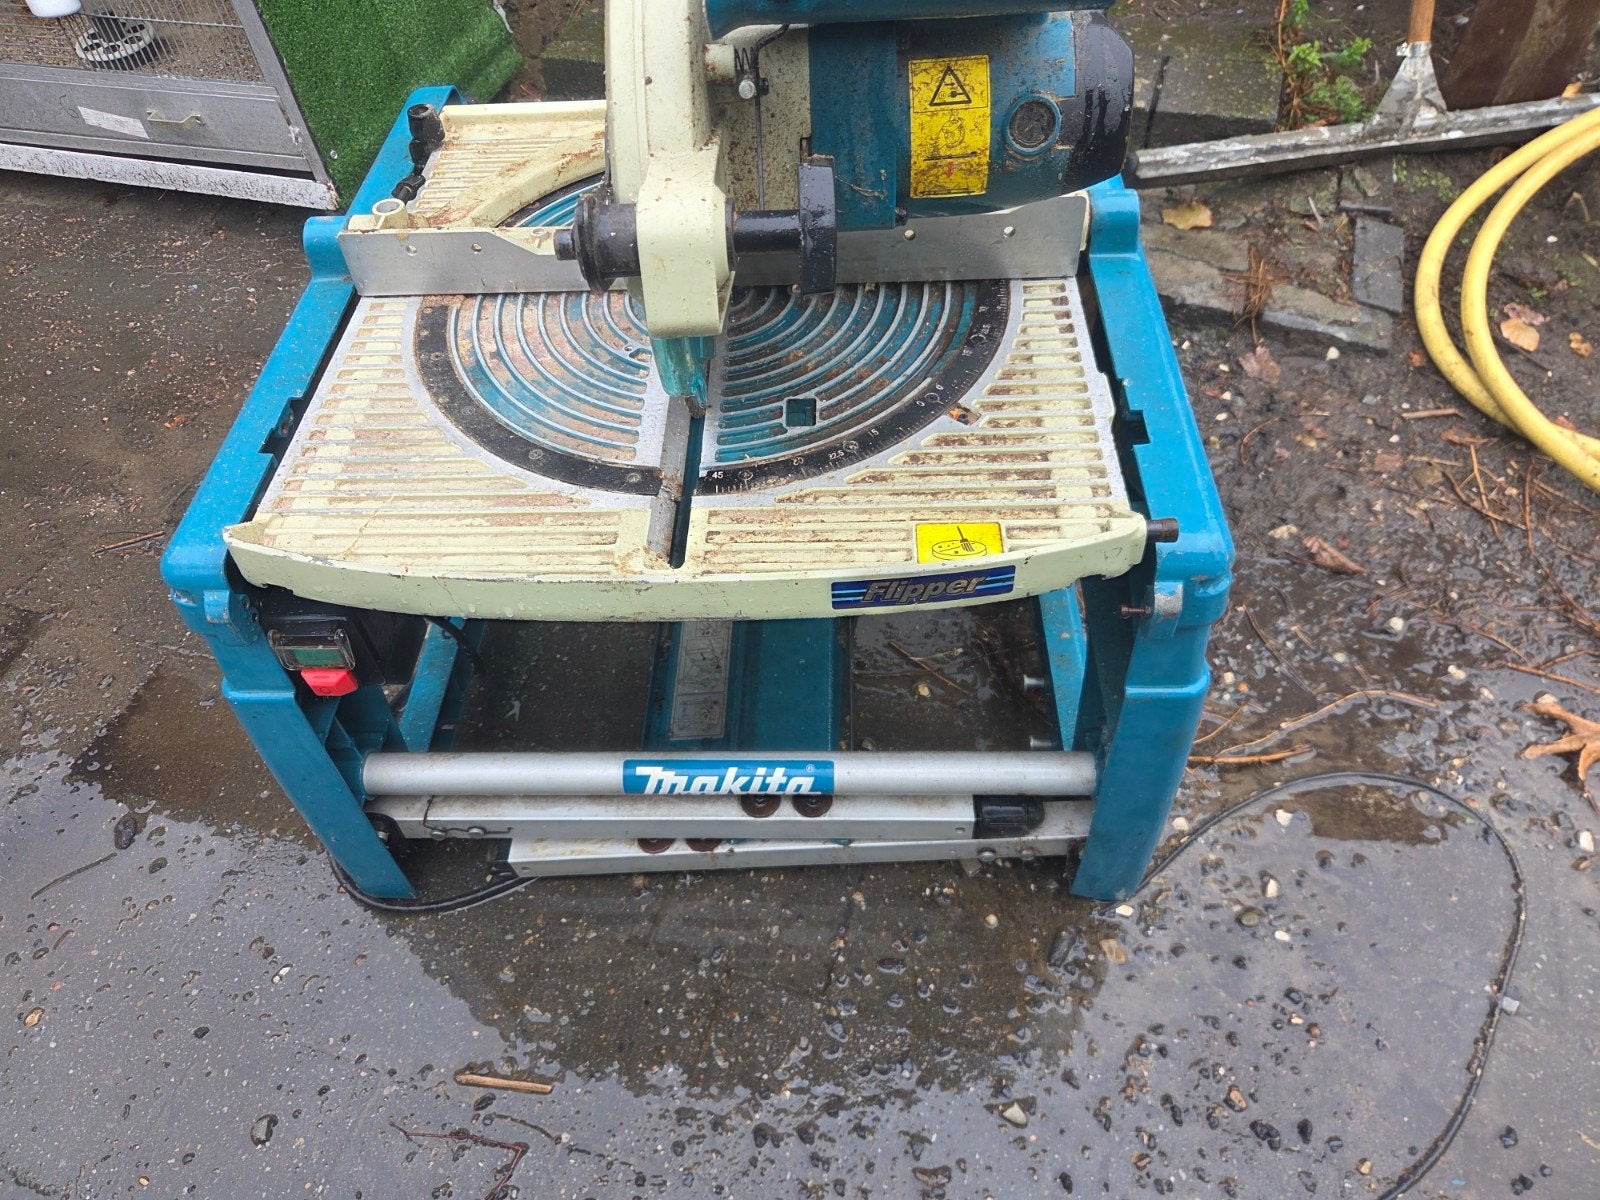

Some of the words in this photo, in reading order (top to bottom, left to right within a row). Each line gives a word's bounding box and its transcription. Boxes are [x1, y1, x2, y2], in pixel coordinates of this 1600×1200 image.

[711, 471, 724, 479] 45
[861, 575, 988, 605] Flipper
[635, 766, 822, 795] Makita
